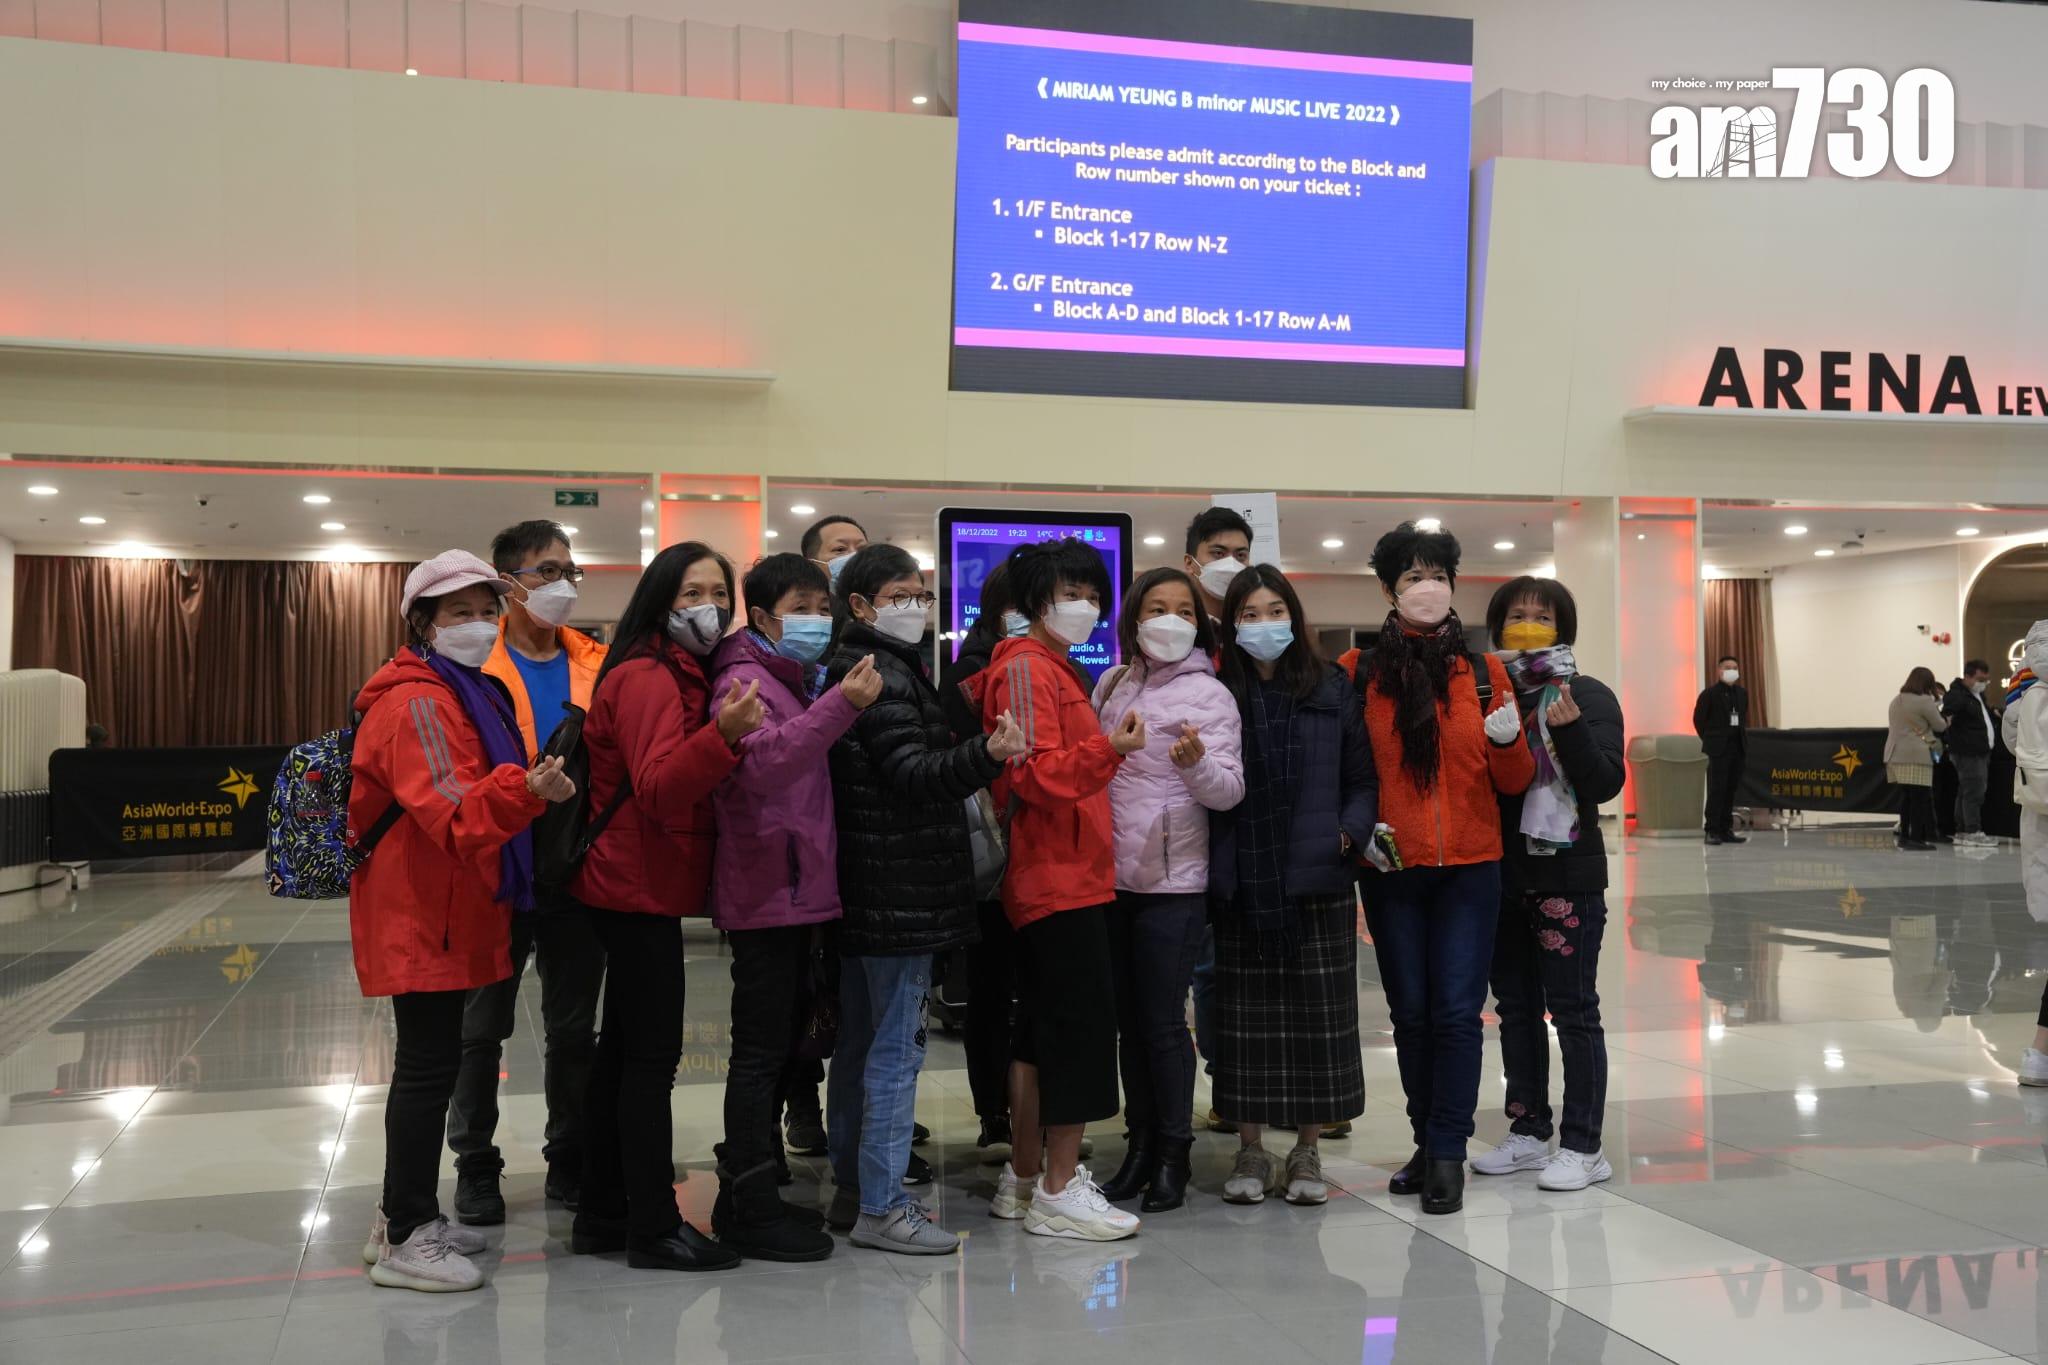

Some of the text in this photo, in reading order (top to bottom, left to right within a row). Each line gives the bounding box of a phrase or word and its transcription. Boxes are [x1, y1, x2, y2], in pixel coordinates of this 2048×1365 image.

[1052, 80, 1115, 102] MIRIAM
[1118, 86, 1177, 107] YEUNG
[1181, 91, 1193, 108] B
[1197, 94, 1246, 113] minor
[1250, 97, 1301, 116] MUSIC
[1305, 101, 1341, 120] LIVE
[1345, 104, 1386, 123] 2022
[1006, 134, 1426, 179] Participants please admit according to the Block and
[1075, 162, 1111, 180] Row
[1115, 167, 1179, 184] number
[1184, 170, 1235, 189] shown
[1239, 176, 1260, 190] on
[1264, 177, 1301, 195] your
[1304, 178, 1351, 197] ticket
[992, 198, 1133, 224] 1. 1/F Entrance
[1054, 226, 1229, 254] Block 1-17 Row N-Z
[990, 271, 1134, 297] 2. G/F Entrance
[1053, 300, 1352, 332] Block A-D and Block 1-17 Row A-M
[1698, 346, 1982, 416] ARENA
[957, 528, 998, 537] 18/12/2022
[1008, 529, 1027, 537] 19:23
[1069, 643, 1095, 653] audio
[1075, 655, 1110, 665] llowed
[1771, 768, 1843, 784] AsiaWorld-Expo
[122, 801, 233, 819] AsiaWorld-Expo
